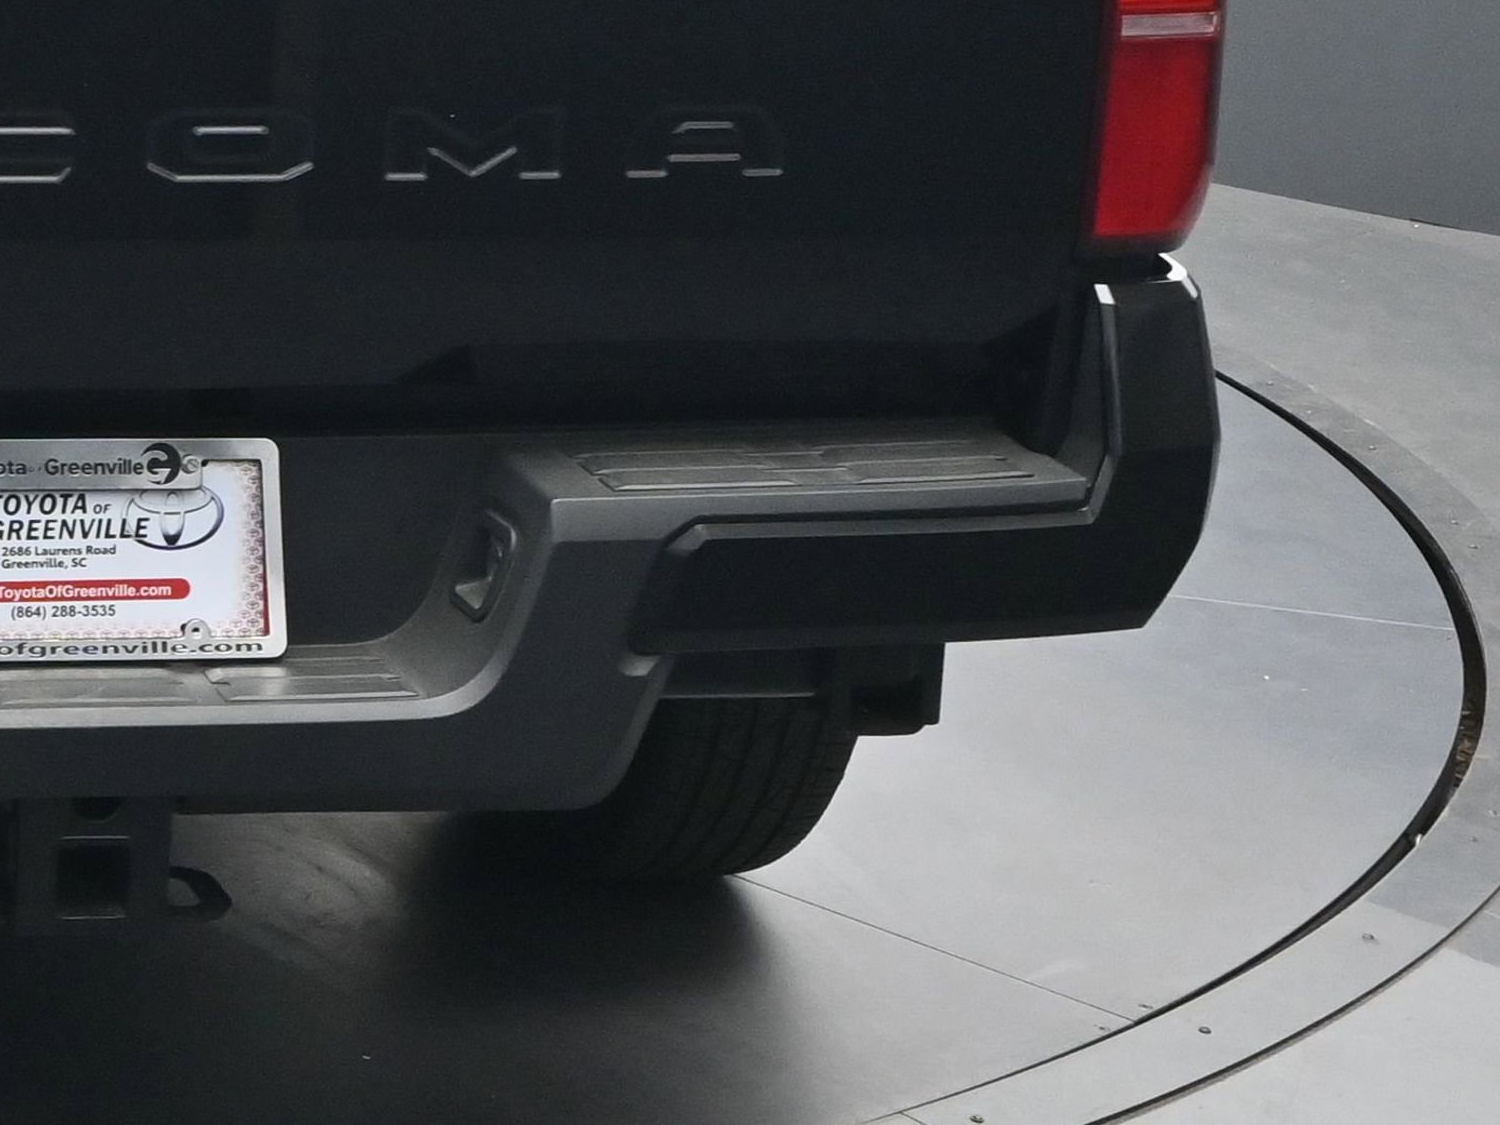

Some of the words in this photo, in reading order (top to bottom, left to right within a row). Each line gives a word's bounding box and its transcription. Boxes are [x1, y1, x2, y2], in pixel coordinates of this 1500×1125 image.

[44, 457, 144, 475] Greenville
[93, 503, 112, 515] OF
[1, 546, 32, 557] 2686
[34, 545, 84, 557] Laurens
[86, 544, 117, 556] Road
[1, 558, 69, 570] Greenville,
[71, 557, 88, 569] SC
[11, 606, 47, 620] (864)
[51, 604, 117, 618] 288-3535
